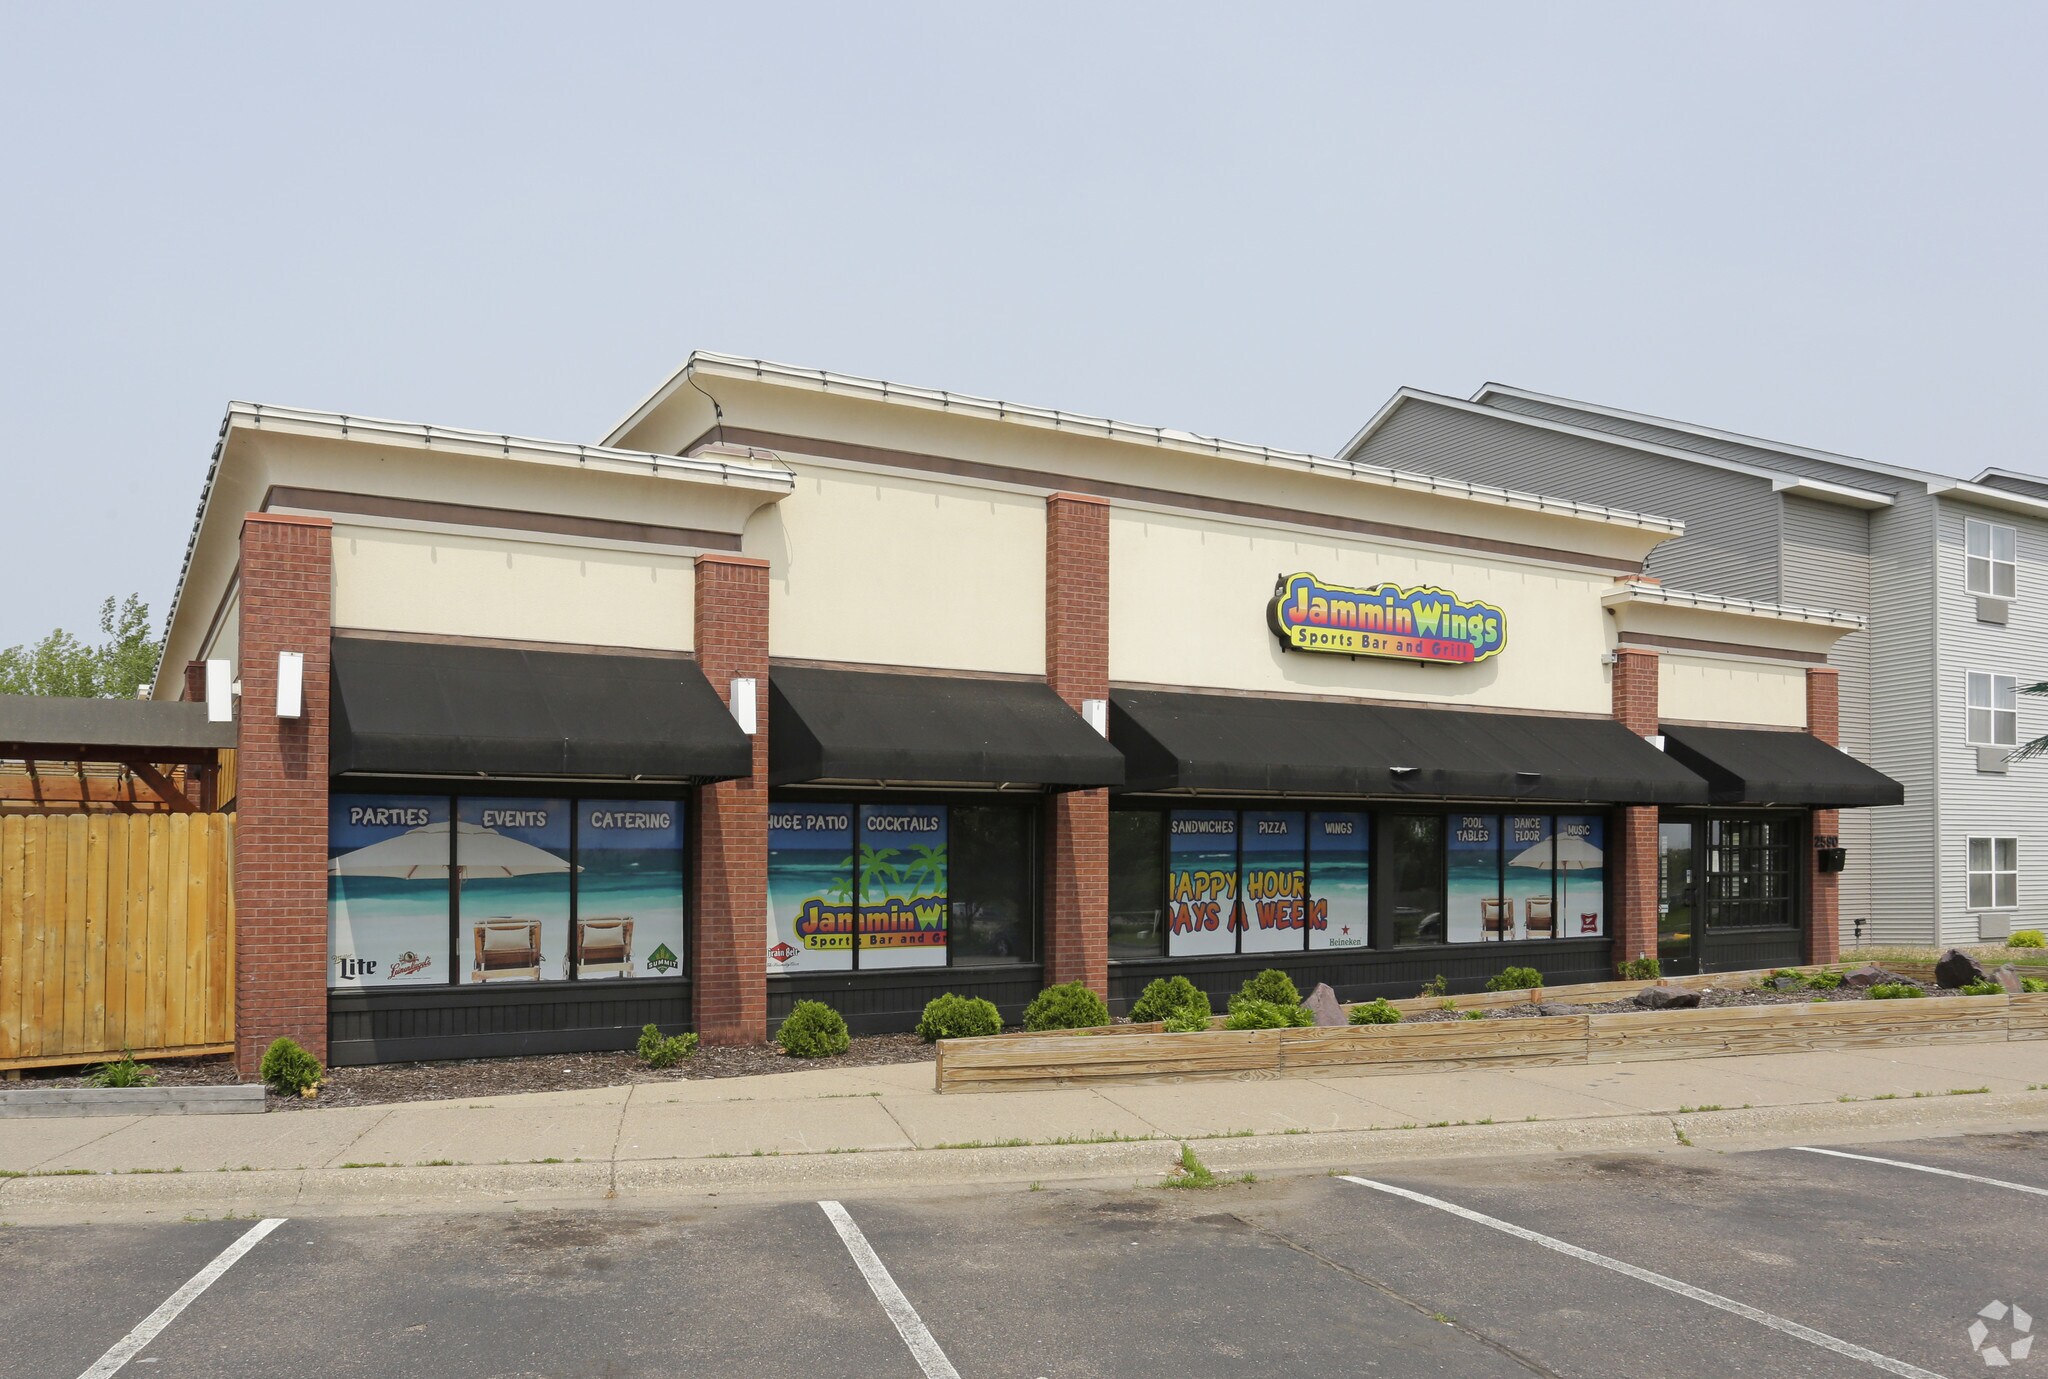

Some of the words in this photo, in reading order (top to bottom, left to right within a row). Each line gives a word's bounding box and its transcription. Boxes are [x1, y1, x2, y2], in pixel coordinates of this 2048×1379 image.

[1298, 628, 1353, 647] Sports
[1361, 634, 1388, 650] Bar
[1396, 640, 1423, 654] and
[1432, 643, 1467, 657] Grill
[350, 807, 429, 825] PARTIES
[482, 809, 548, 828] EVENTS
[591, 811, 671, 829] CATERING
[806, 814, 848, 831] PATIO
[867, 816, 939, 832] COCKTAILS
[1171, 820, 1234, 834] SANDWICHES
[1258, 821, 1288, 834] PIZZA
[1324, 822, 1353, 834] WINGS
[1462, 817, 1484, 829] POOL
[1514, 817, 1540, 829] DANCE
[1456, 830, 1489, 842] TABLES
[1515, 830, 1540, 842] FLOOR
[1567, 824, 1590, 836] MUSIC
[870, 935, 893, 946] Bar
[901, 933, 924, 944] and
[1329, 938, 1361, 946] Heineken
[340, 958, 377, 980] Lite
[648, 959, 676, 968] SUMMIT
